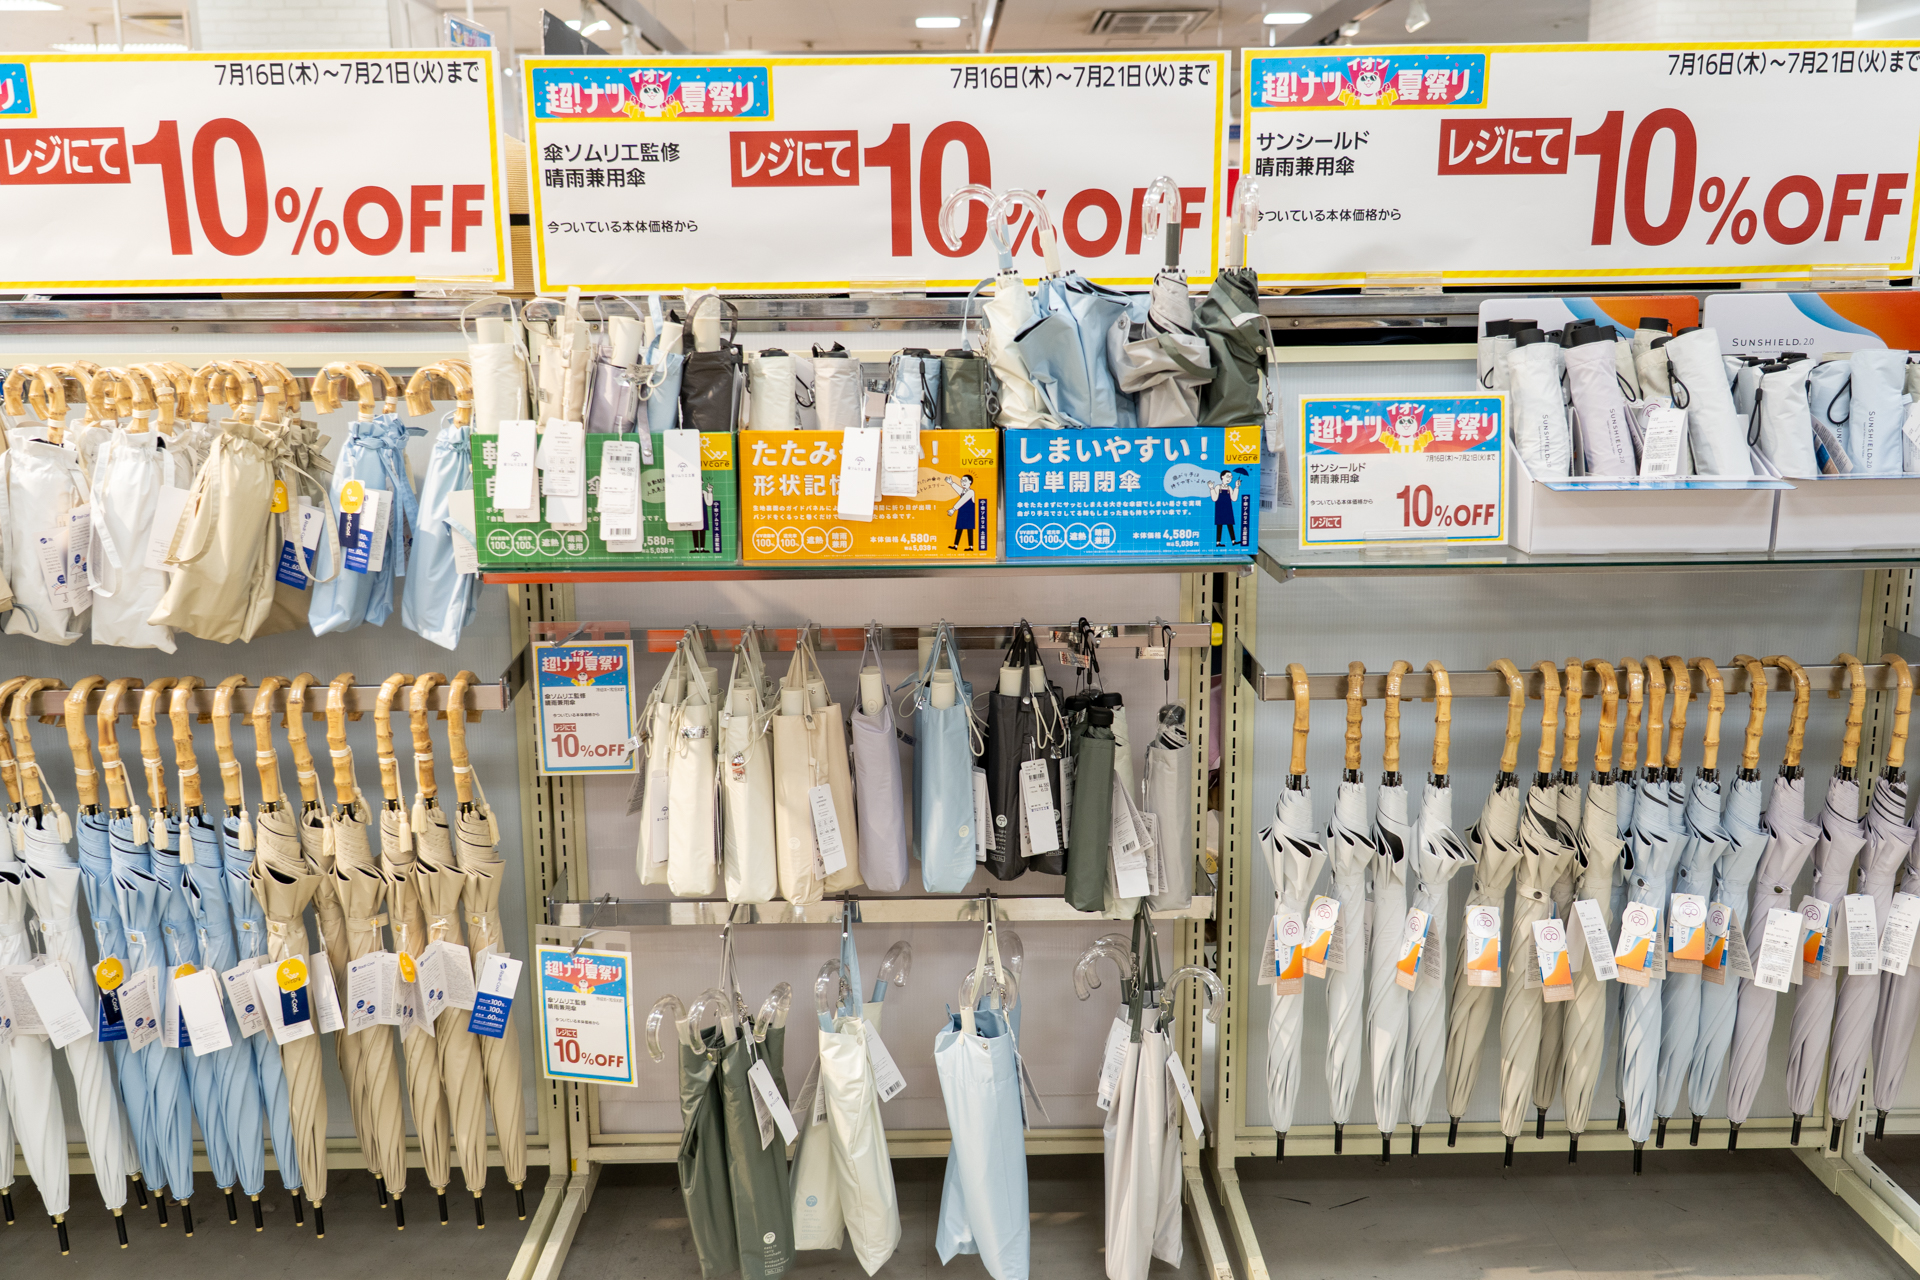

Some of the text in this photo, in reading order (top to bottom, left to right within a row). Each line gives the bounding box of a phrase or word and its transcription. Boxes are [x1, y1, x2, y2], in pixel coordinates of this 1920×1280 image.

[1346, 57, 1391, 71] イオン
[629, 69, 672, 83] イオン
[1256, 130, 1370, 152] サンシールド
[1447, 126, 1564, 166] レジにて
[4, 136, 121, 176] レジにて
[544, 142, 681, 163] 傘ソムリエ監修
[740, 137, 852, 178] レジにて
[1255, 156, 1355, 177] 晴雨兼用傘
[545, 167, 646, 188] 晴雨兼用傘
[547, 219, 699, 235] 今ついている本体価格から
[1386, 403, 1426, 415] イオン
[962, 458, 994, 466] UVcare
[1226, 454, 1258, 462] UVcare
[1310, 463, 1366, 473] サンシールド
[1018, 470, 1141, 493] 簡単開閉傘
[1310, 474, 1360, 484] 晴雨兼用傘
[1311, 517, 1342, 528] レジにて
[556, 1028, 577, 1038] レジにて
